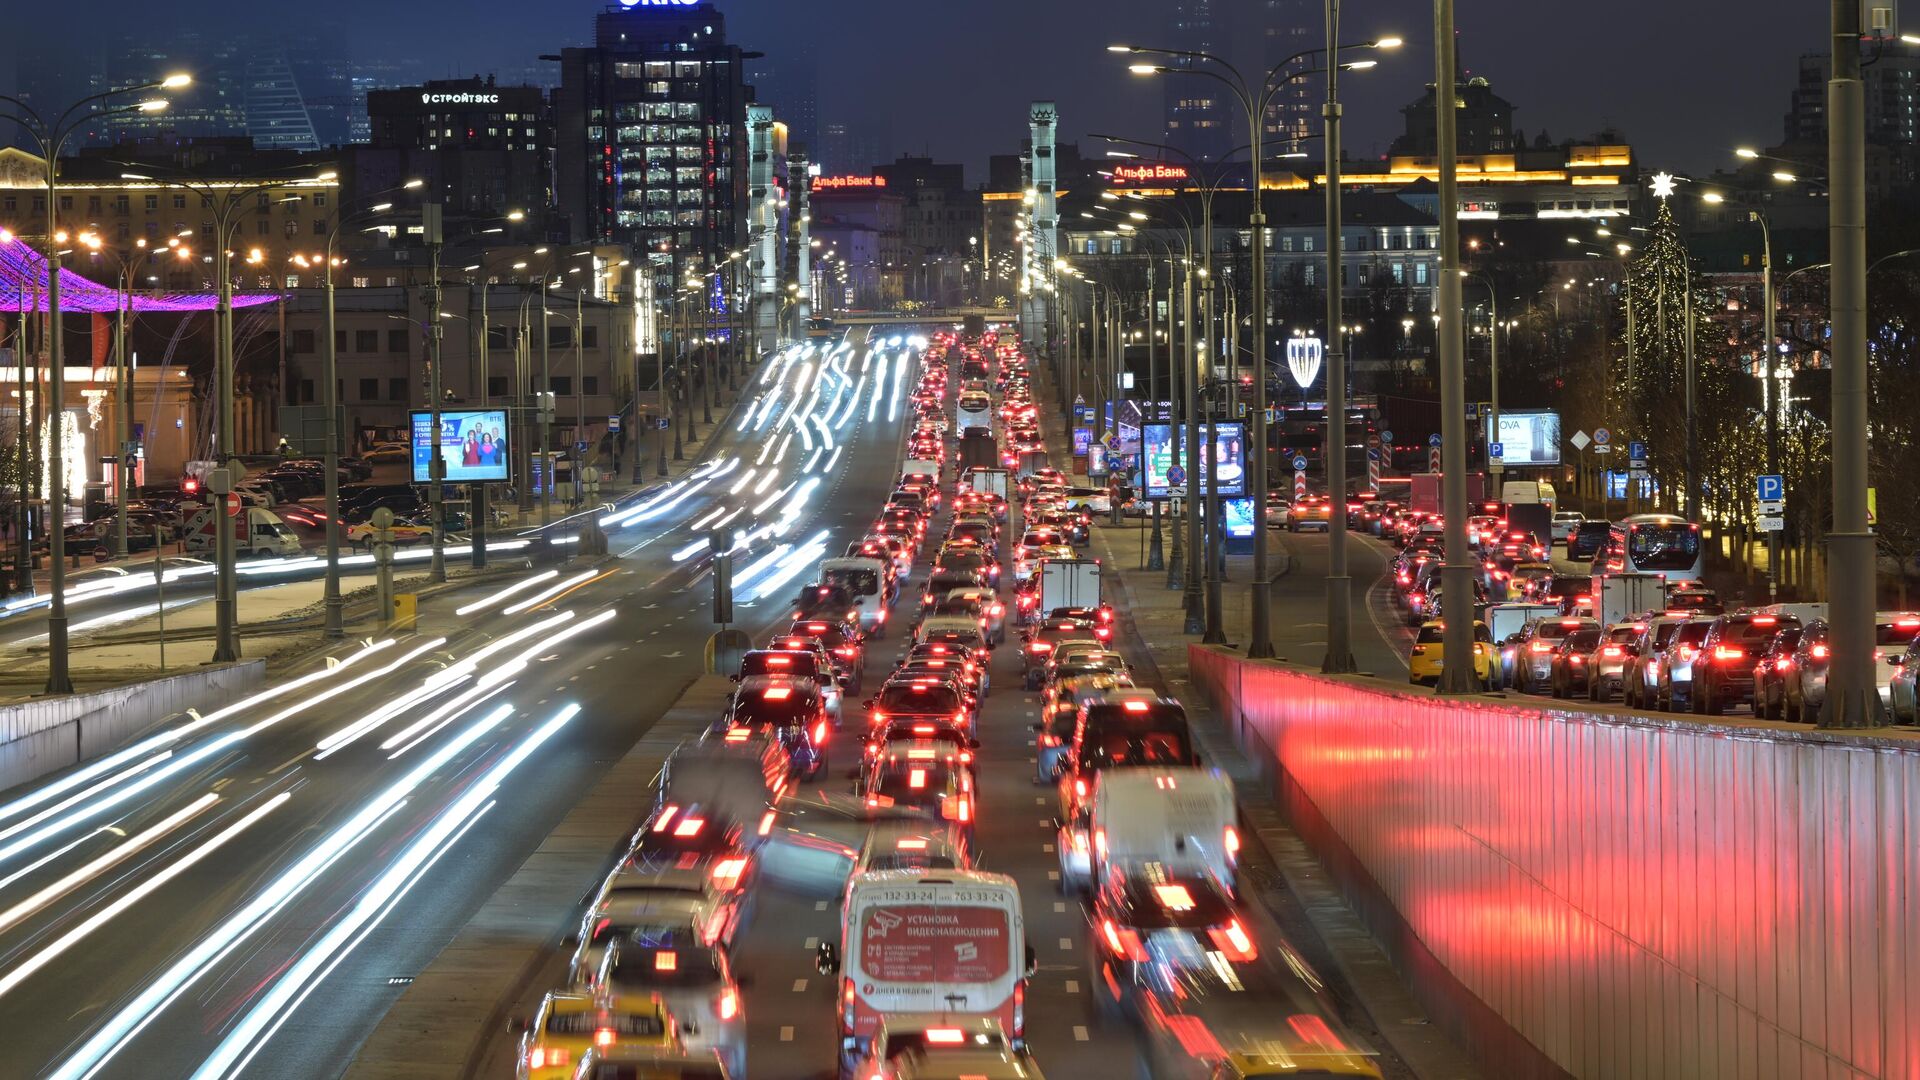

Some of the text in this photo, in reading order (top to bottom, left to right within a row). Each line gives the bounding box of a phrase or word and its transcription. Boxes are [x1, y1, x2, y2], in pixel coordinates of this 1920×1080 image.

[431, 93, 499, 103] СТРОЙТЭКС
[1115, 165, 1187, 181] Альфа Банк
[812, 175, 872, 189] Альфа Банк
[1492, 445, 1501, 455] P
[1634, 444, 1643, 457] P
[1764, 478, 1777, 498] P
[885, 892, 933, 901] 132-33-24
[954, 892, 1004, 901] 763-33-24
[907, 915, 959, 925] УСТАНОВКА
[907, 927, 999, 937] ВИДЕОНАБЛЮДЕНИЯ
[902, 987, 932, 995] НЕДЕЛЮ
